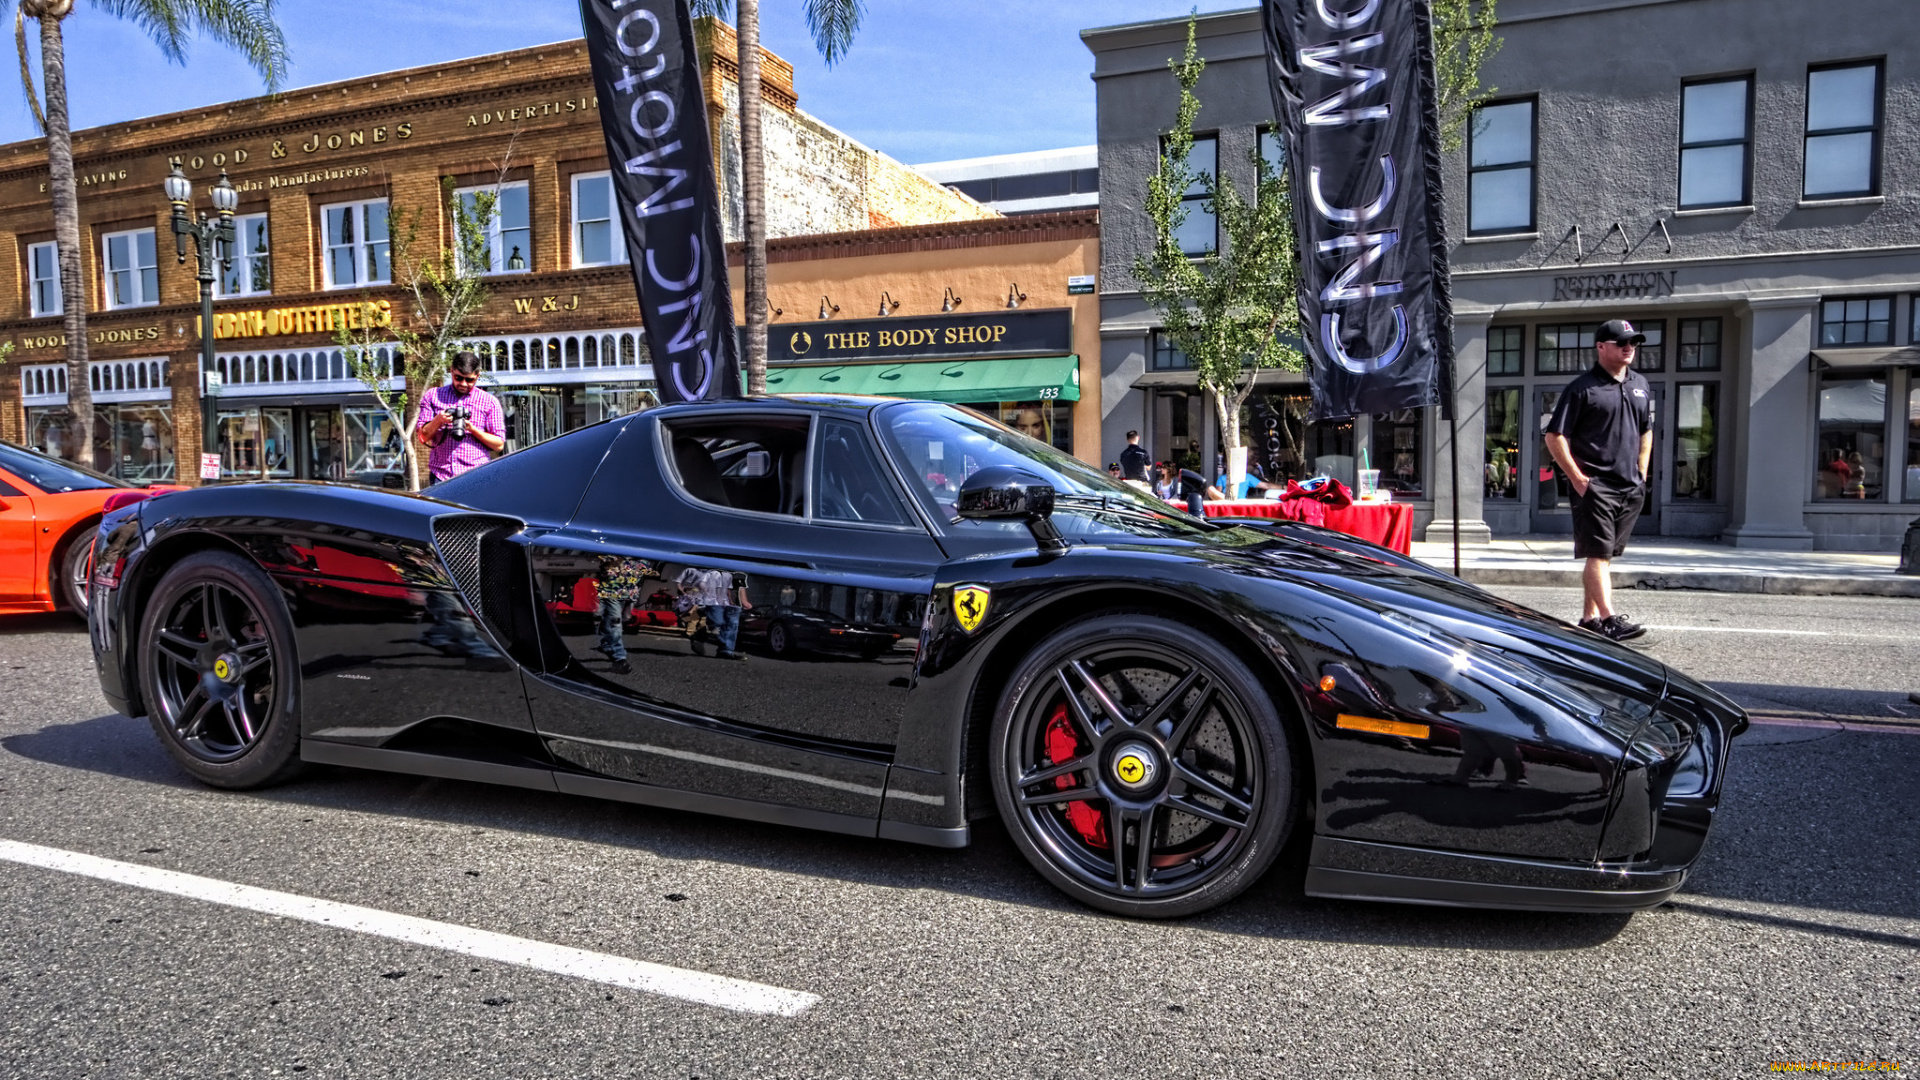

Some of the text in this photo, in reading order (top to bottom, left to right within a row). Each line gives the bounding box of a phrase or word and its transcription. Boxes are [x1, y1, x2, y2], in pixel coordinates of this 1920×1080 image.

[270, 140, 287, 159] &
[303, 123, 412, 153] JONES
[39, 169, 127, 193] EAVING
[269, 165, 369, 188] Manufacturers
[612, 0, 713, 401] CNC Moto
[1309, 152, 1410, 375] CNC
[1552, 270, 1678, 301] RESTORATION
[513, 294, 579, 314] W & J
[196, 299, 392, 340] RBAN OUTFITTERS
[94, 326, 159, 344] JONES
[824, 325, 1007, 350] THE BODY SHOP
[1039, 387, 1059, 399] 133
